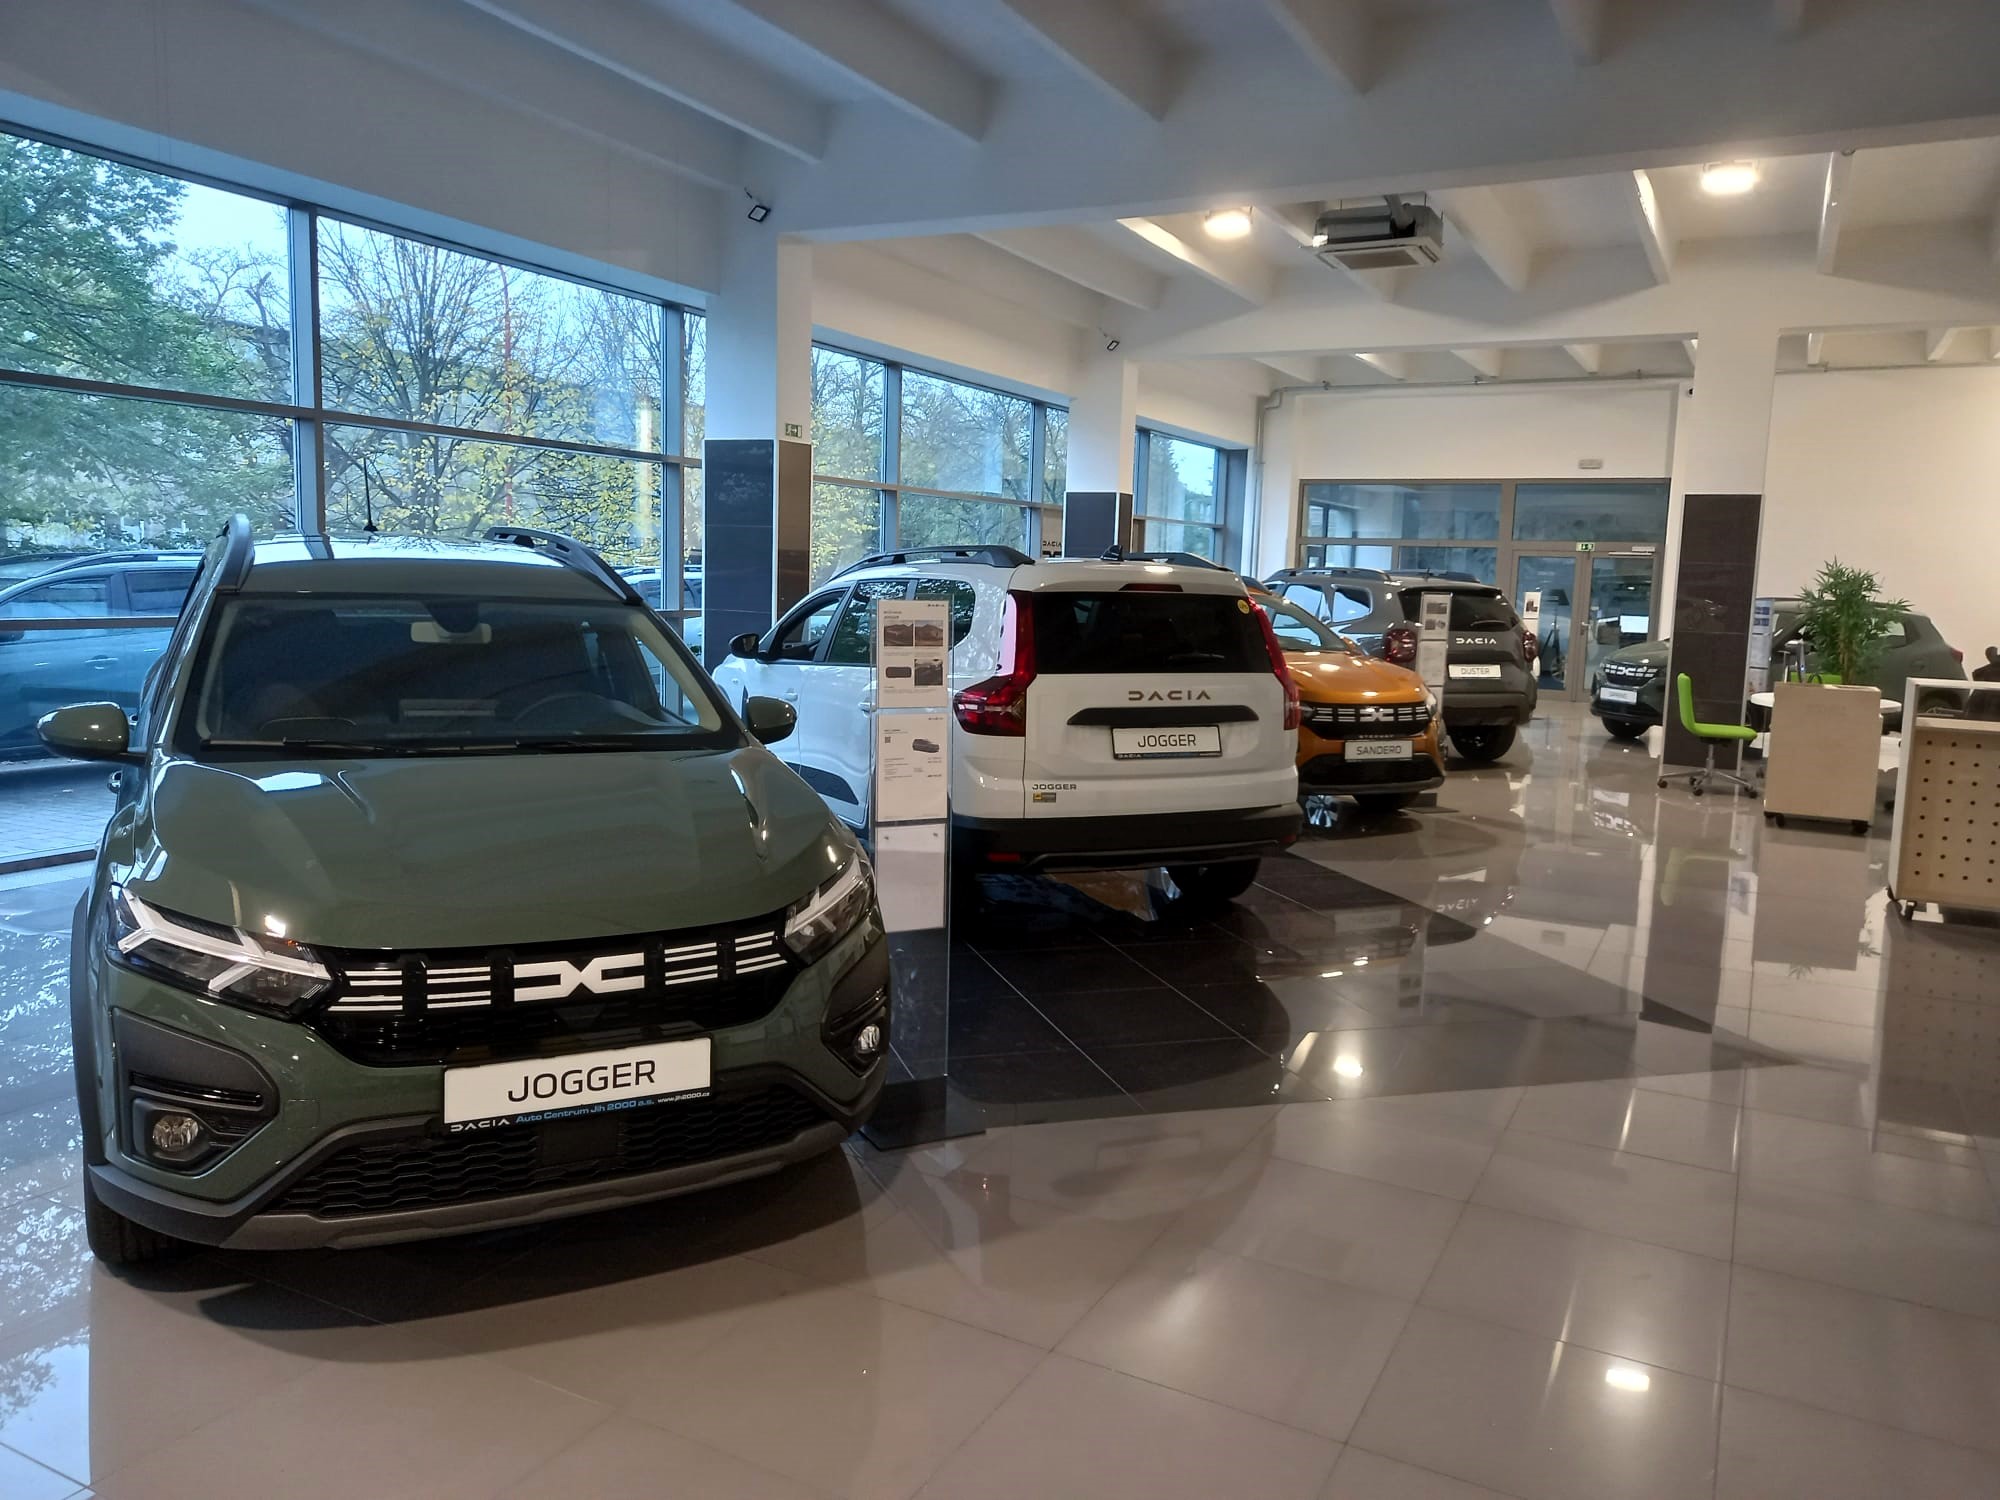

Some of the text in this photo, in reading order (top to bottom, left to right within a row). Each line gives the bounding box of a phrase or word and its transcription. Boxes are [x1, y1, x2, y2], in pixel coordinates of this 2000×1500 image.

[1455, 637, 1497, 645] DACIA
[1128, 690, 1211, 701] DACIA
[1137, 734, 1197, 748] JOGGER
[1356, 745, 1402, 755] SANDERO
[1031, 783, 1077, 791] JOGGER
[507, 1059, 656, 1103] JOGGER
[450, 1118, 511, 1132] DACIA
[515, 1114, 542, 1124] Auto
[543, 1107, 589, 1120] Centrum
[607, 1099, 637, 1111] 2000
